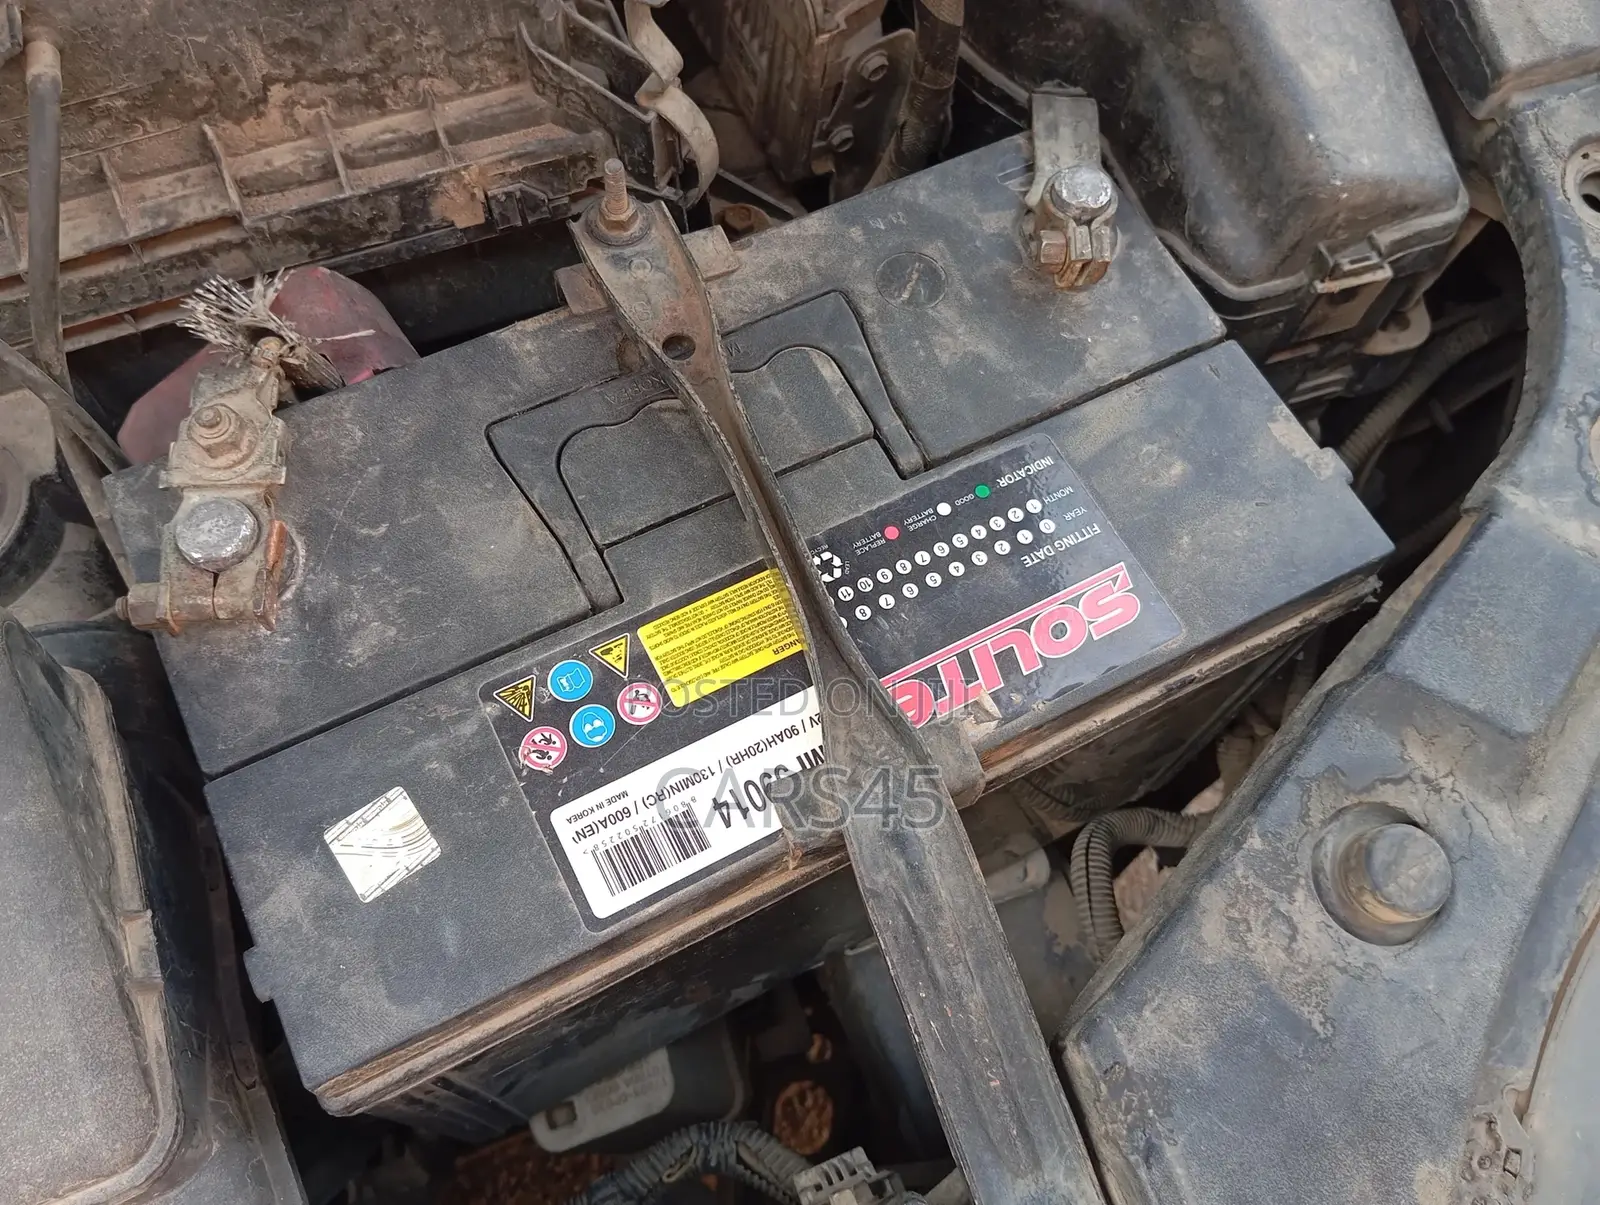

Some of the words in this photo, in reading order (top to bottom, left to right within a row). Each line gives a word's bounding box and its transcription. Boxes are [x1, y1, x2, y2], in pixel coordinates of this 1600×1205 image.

[953, 492, 974, 506] GOOD
[1042, 485, 1073, 504] MONTH
[1030, 502, 1036, 510] 1
[1062, 505, 1087, 521] YEAR
[901, 507, 934, 525] BATTERY
[1011, 510, 1019, 519] 2
[906, 514, 937, 531] CHARGE
[992, 519, 1000, 528] 3
[850, 531, 881, 548] BATTERY
[974, 528, 982, 536] 4
[1052, 522, 1101, 551] FITTING
[854, 537, 885, 555] REPLACE
[955, 536, 964, 545] 5
[937, 545, 945, 553] 6
[1019, 544, 1054, 567] DATE
[918, 553, 926, 562] 7
[899, 562, 907, 571] 8
[880, 571, 888, 580] 9
[858, 579, 872, 590] 10
[839, 588, 851, 598] 11
[772, 638, 800, 655] ANGER
[724, 722, 800, 768] 90AH(20HR)
[640, 763, 716, 810] 130MIN(RC)
[604, 789, 628, 806] MADE
[594, 801, 604, 811] IN
[565, 805, 595, 825] KOREA
